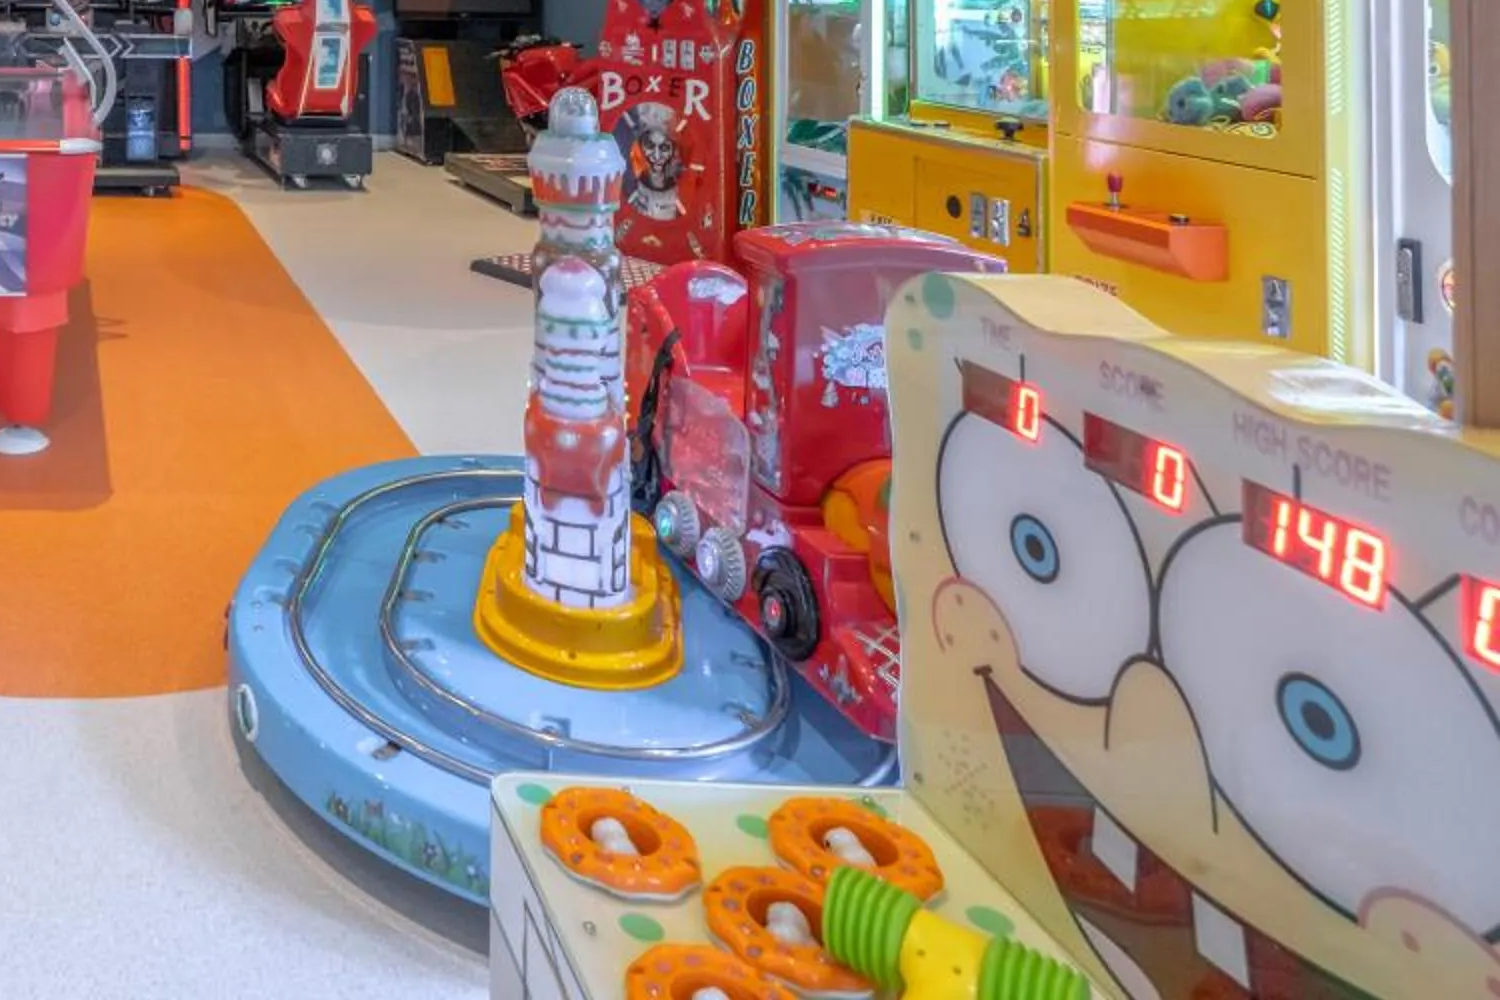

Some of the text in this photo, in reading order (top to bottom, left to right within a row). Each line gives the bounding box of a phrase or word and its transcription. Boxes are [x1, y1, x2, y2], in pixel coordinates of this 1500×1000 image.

[601, 71, 711, 120] BOXER
[736, 39, 758, 225] BOXER
[1233, 411, 1393, 503] HIGH SCORE
[1274, 501, 1385, 605] 148
